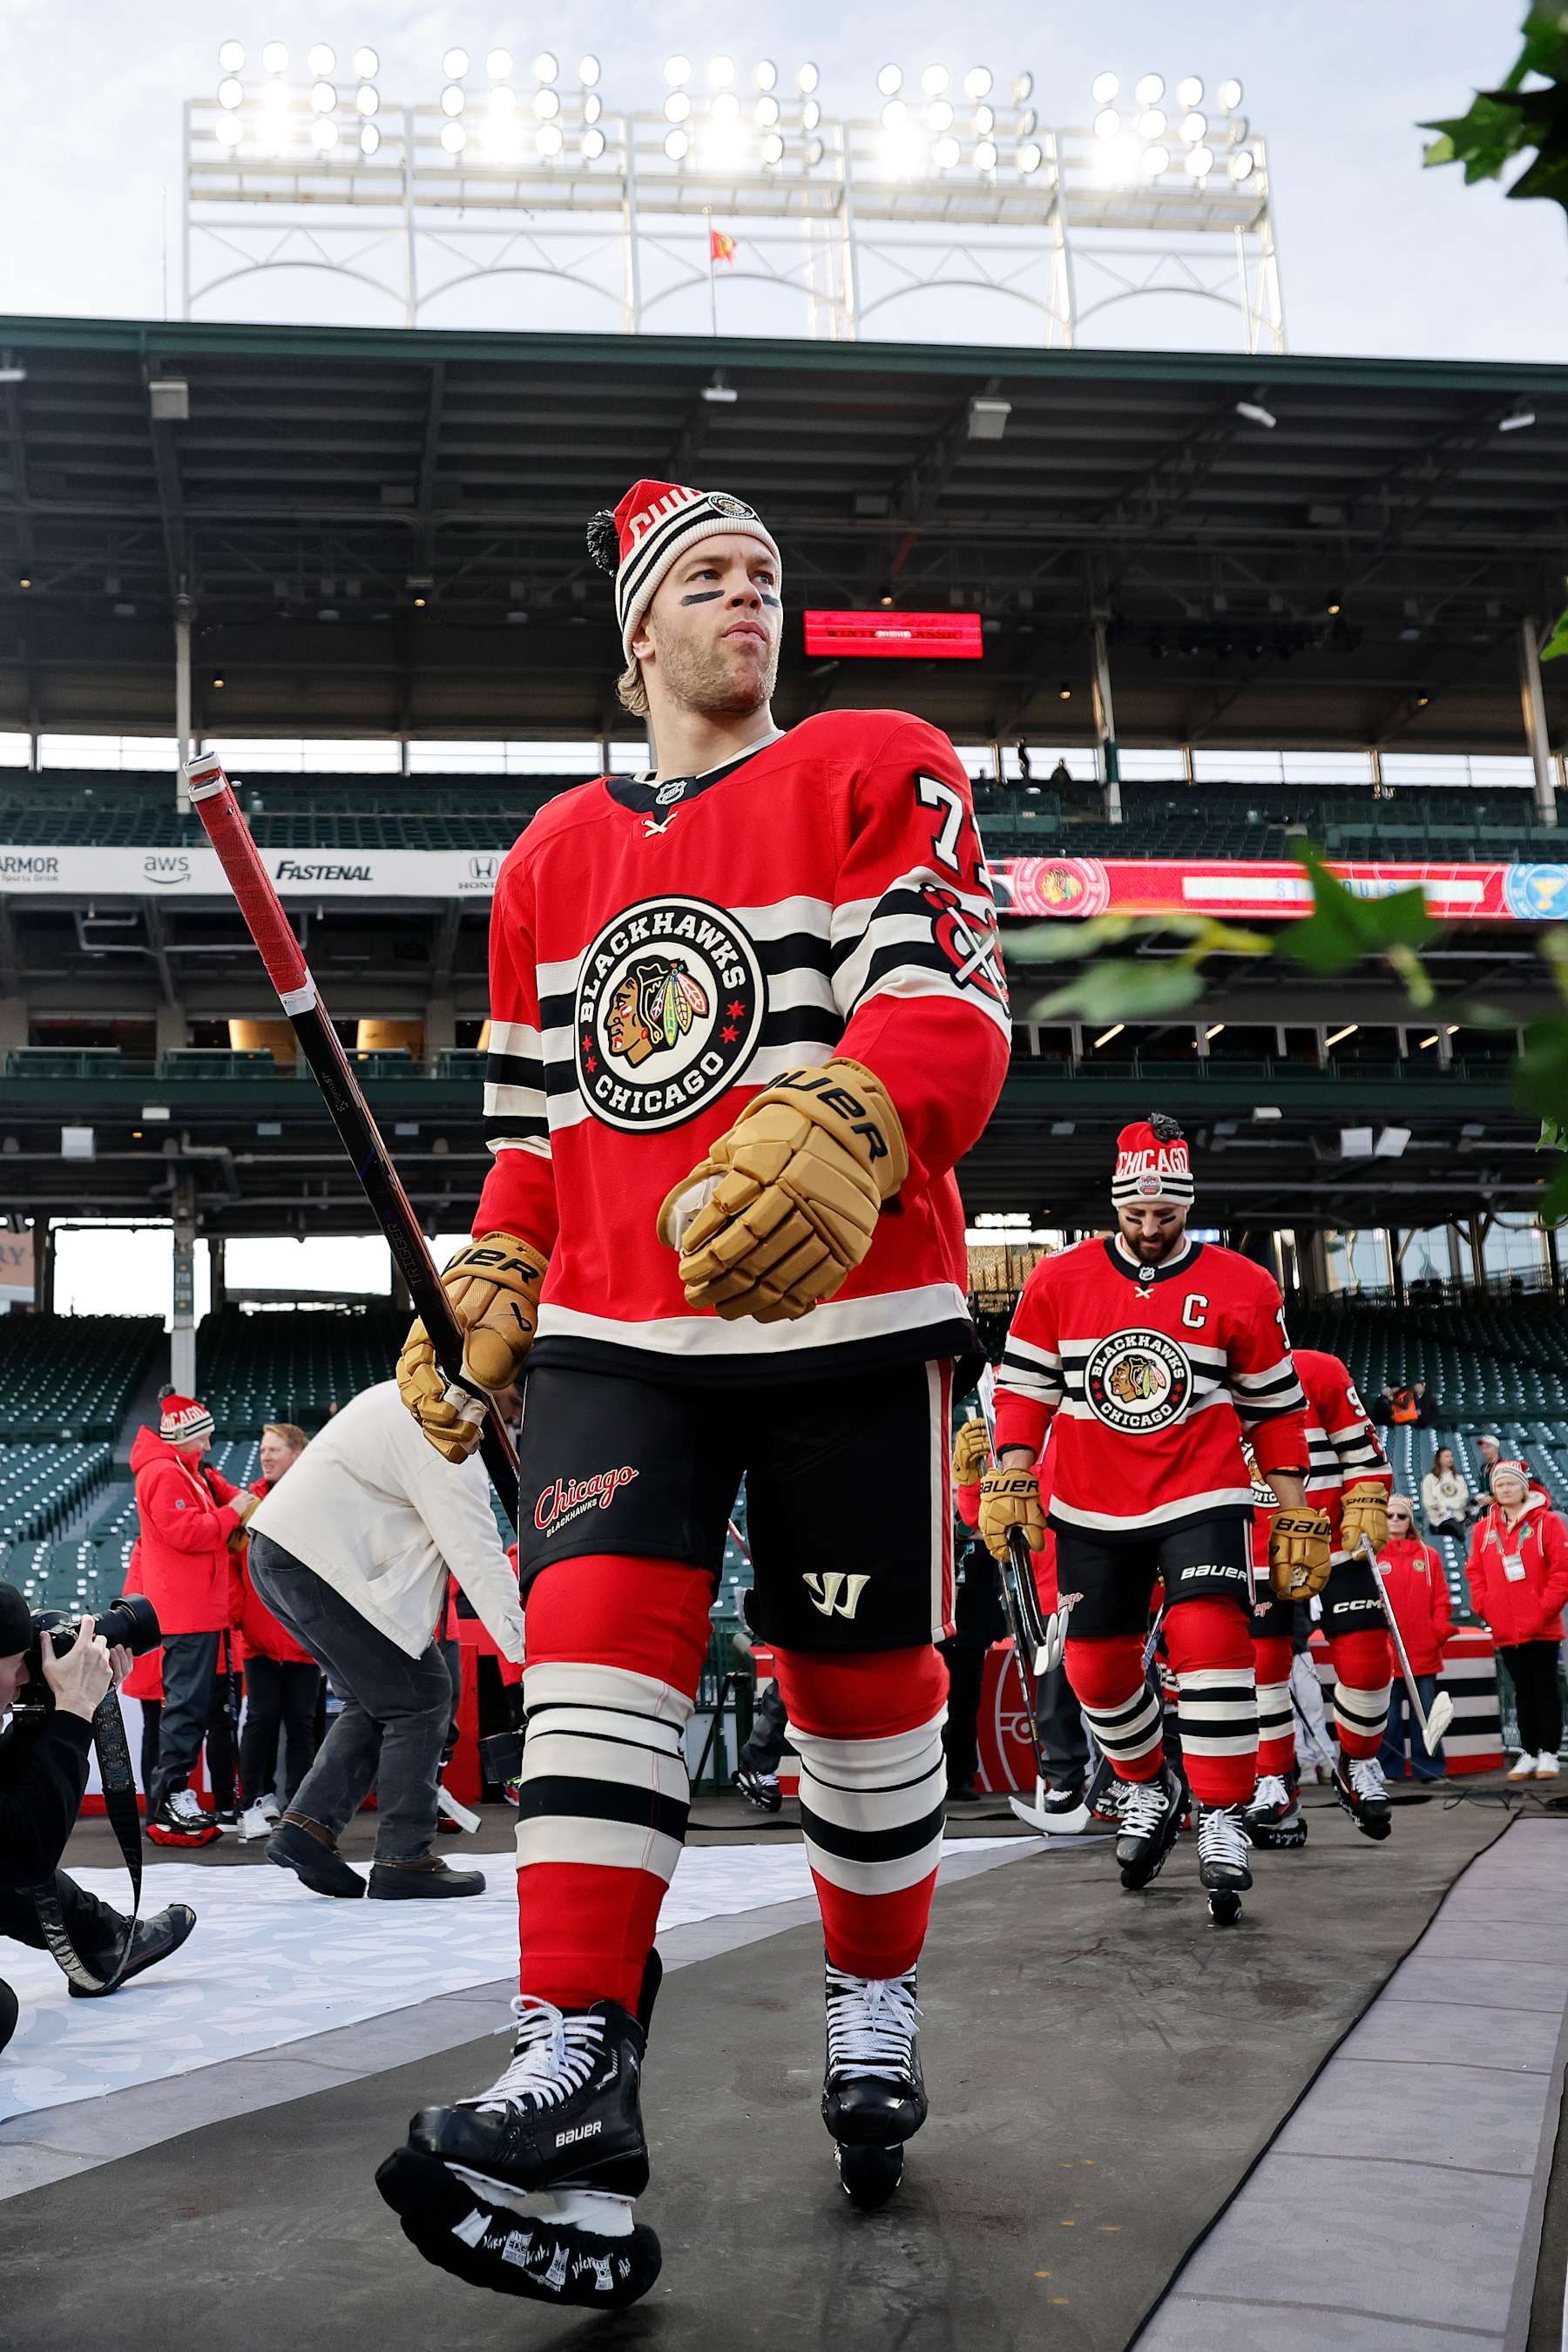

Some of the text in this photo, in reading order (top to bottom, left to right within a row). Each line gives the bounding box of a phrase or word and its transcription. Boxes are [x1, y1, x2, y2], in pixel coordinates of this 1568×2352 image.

[144, 856, 189, 871] aws
[275, 861, 373, 881] FASTENAL
[580, 912, 747, 1024] BLACKHAWKS
[595, 1051, 725, 1114] CHICAGO
[763, 1071, 889, 1165] UER
[1115, 1147, 1188, 1176] CHICAGO
[442, 1248, 540, 1285] UER
[1182, 1294, 1209, 1328] C
[1092, 1335, 1185, 1379] BLACKHAWKS
[1100, 1402, 1173, 1427] CHICAGO
[534, 1465, 639, 1531] Chicago
[546, 1497, 598, 1538] BLACKHAWKS
[1180, 1565, 1247, 1583] BAUER
[1333, 1599, 1383, 1614] CCM
[556, 2120, 602, 2148] BAUER
